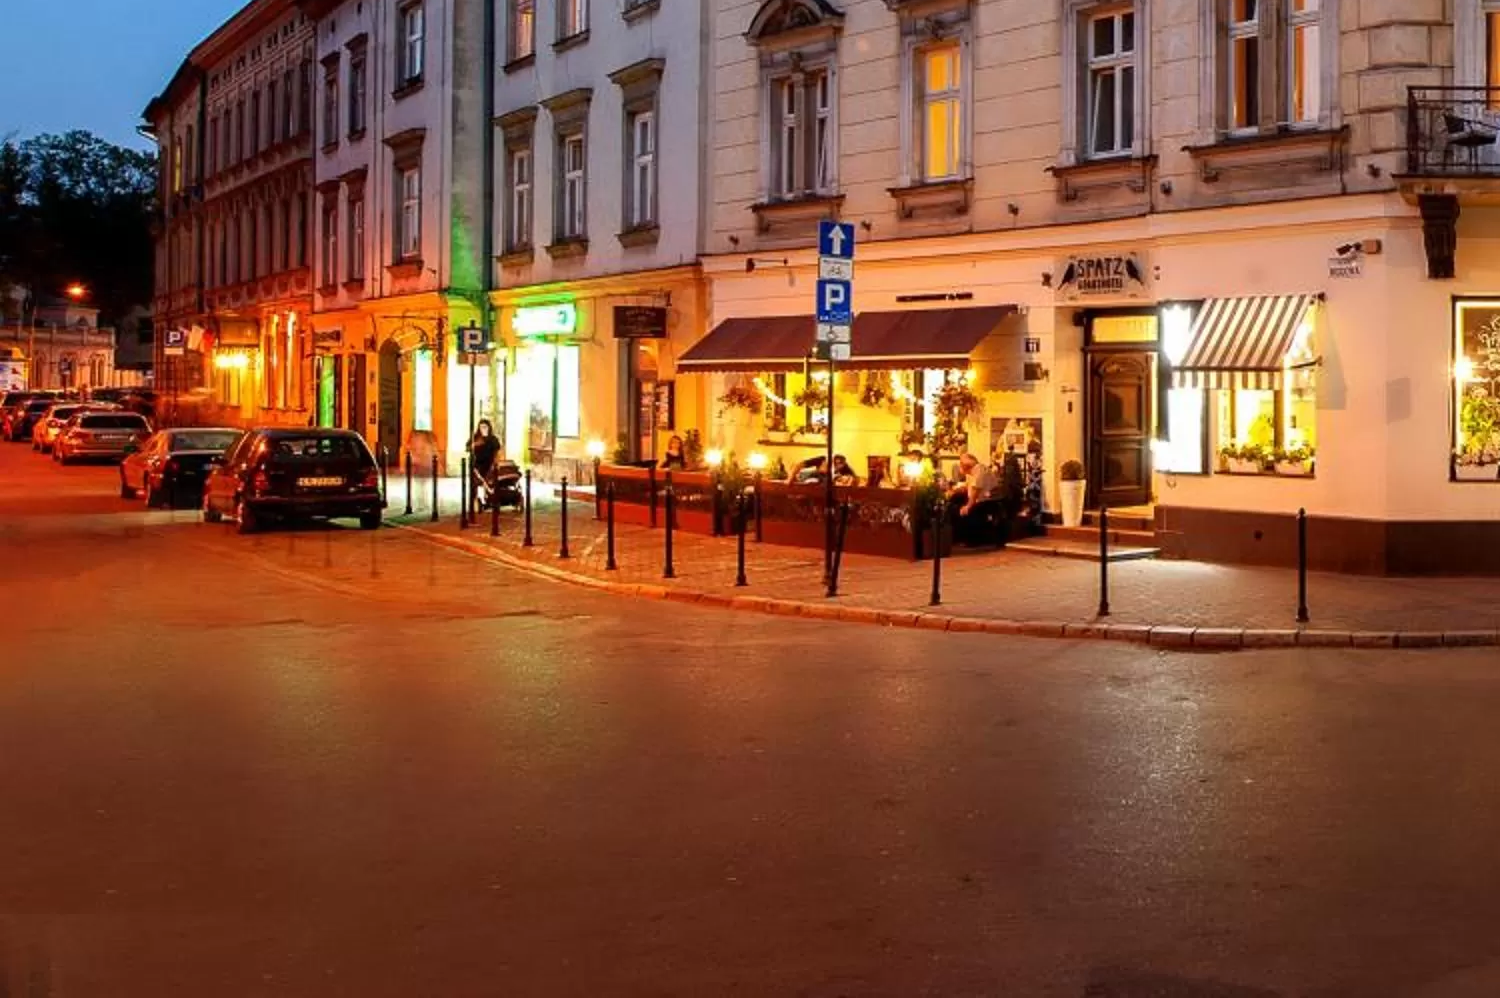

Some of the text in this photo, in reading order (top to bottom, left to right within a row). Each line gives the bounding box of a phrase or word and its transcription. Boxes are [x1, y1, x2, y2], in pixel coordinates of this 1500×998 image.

[1077, 257, 1124, 278] SPATZ
[825, 283, 844, 311] P
[169, 331, 180, 343] P
[463, 330, 482, 350] P
